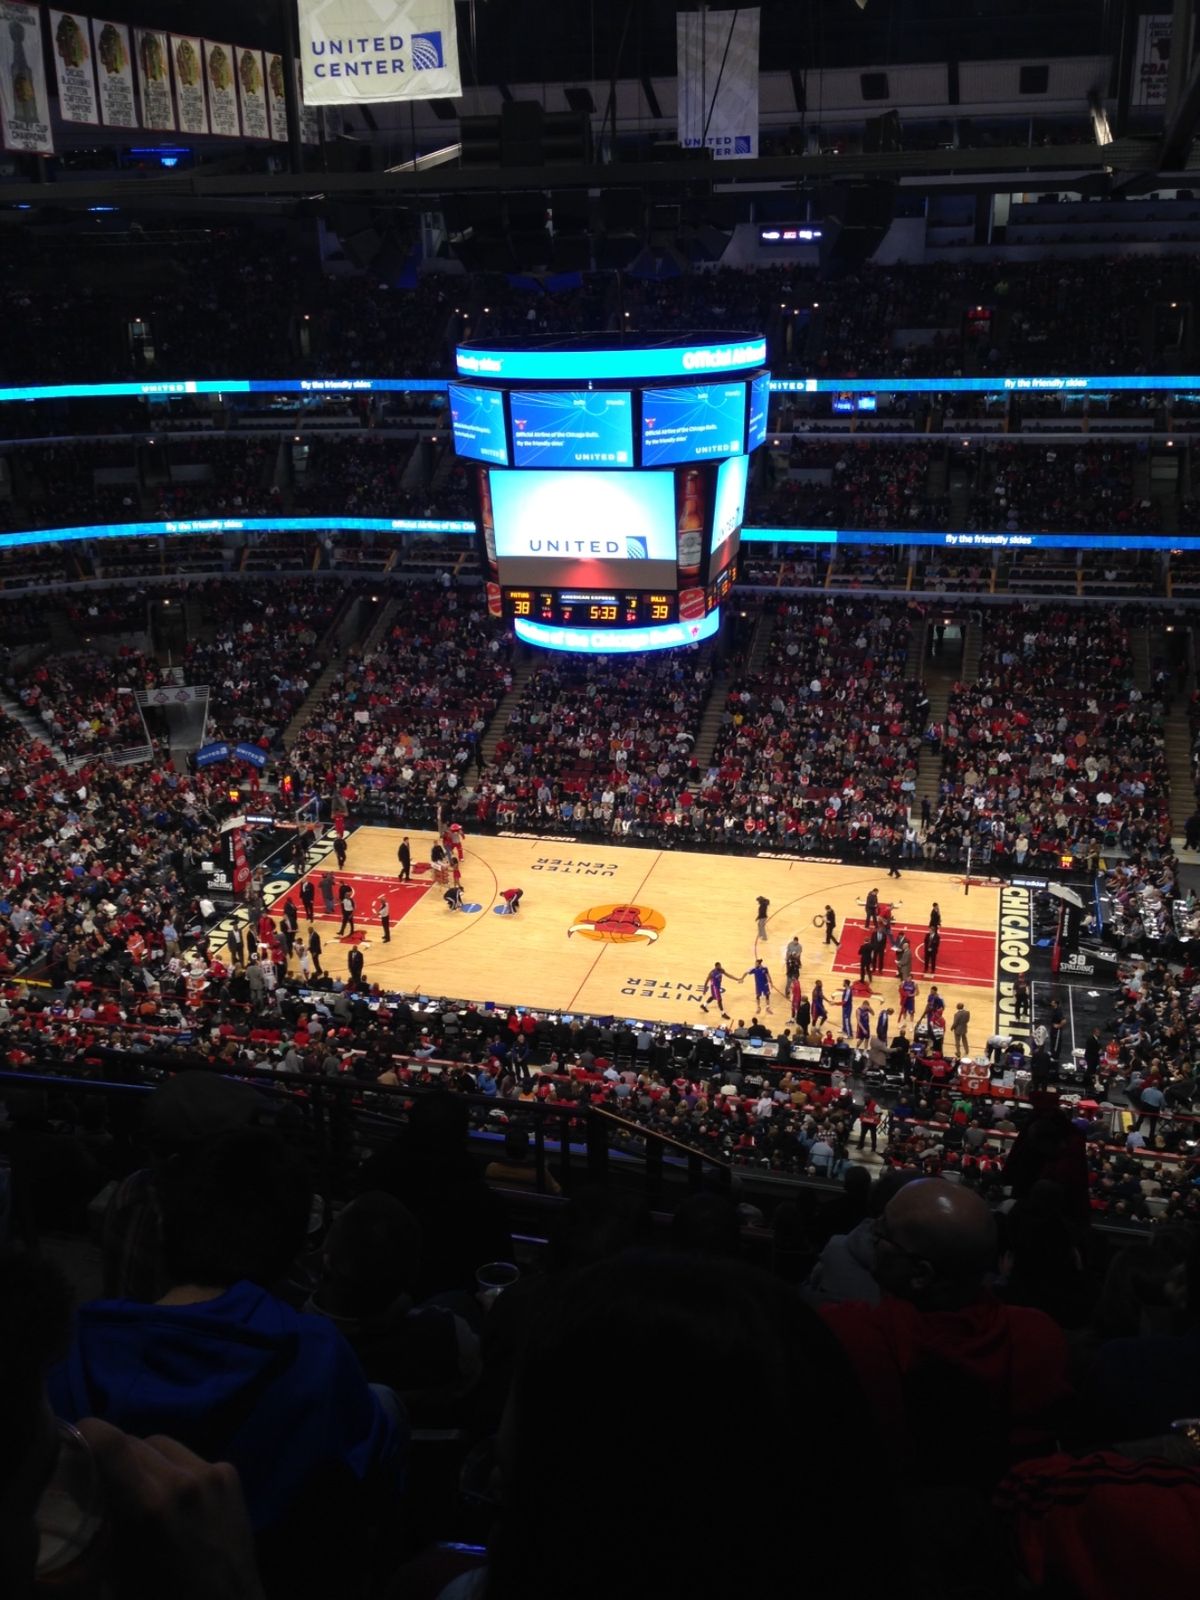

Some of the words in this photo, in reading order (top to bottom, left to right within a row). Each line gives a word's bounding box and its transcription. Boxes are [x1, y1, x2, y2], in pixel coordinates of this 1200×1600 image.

[312, 37, 404, 56] UNITED
[314, 59, 405, 78] CENTER
[769, 382, 804, 390] NITED
[1004, 379, 1016, 389] fly
[1017, 379, 1031, 388] the
[1032, 378, 1065, 389] friendly
[1066, 378, 1088, 388] skies
[695, 444, 728, 454] UNITED
[575, 453, 615, 461] UNITED
[945, 534, 957, 544] fly
[959, 534, 973, 544] the
[974, 534, 1008, 545] friendly
[1009, 535, 1032, 545] skies
[529, 540, 620, 553] UNITED
[514, 601, 530, 614] 38
[590, 606, 617, 620] 5:33
[651, 605, 668, 619] 39
[497, 830, 577, 842] Bulls.com
[536, 858, 618, 870] CENTER
[756, 851, 843, 864] Bulls.com
[530, 864, 615, 877] UNITED
[1000, 887, 1030, 974] CHICAGO
[1059, 962, 1094, 975] SPALDING
[620, 987, 703, 1003] NITED
[968, 1079, 980, 1089] G
